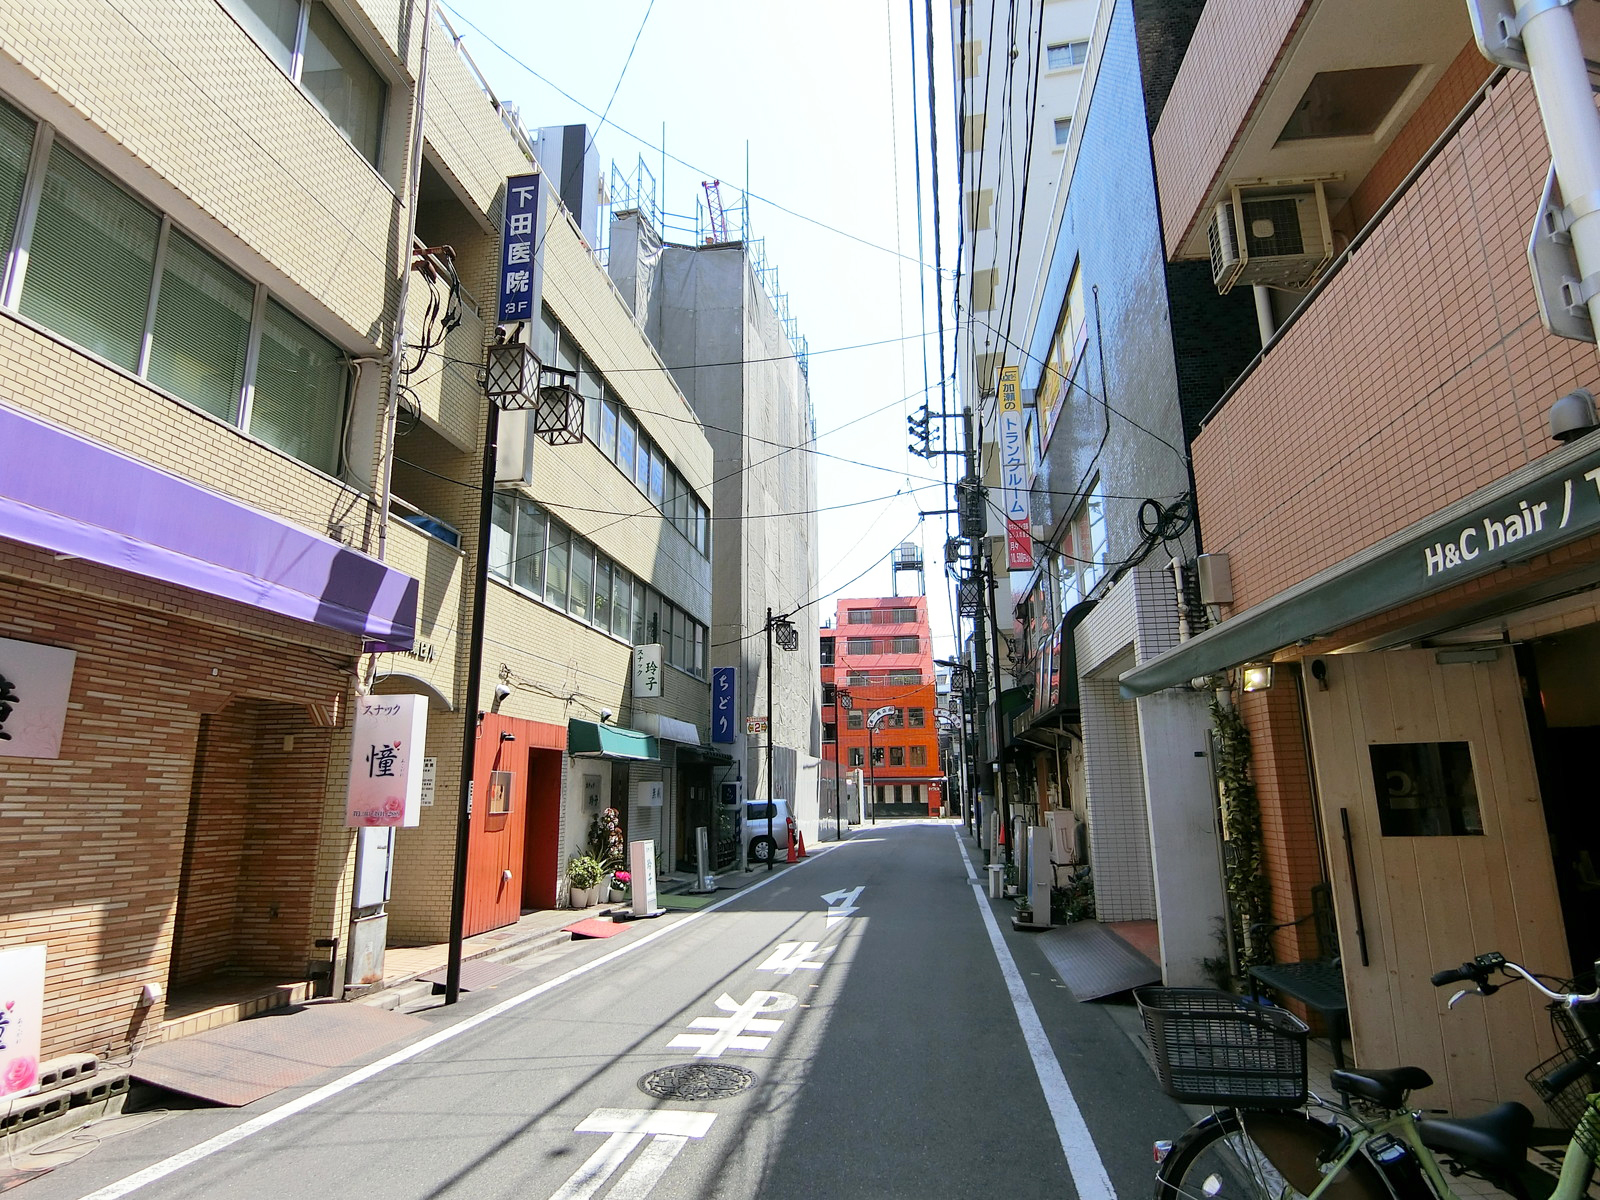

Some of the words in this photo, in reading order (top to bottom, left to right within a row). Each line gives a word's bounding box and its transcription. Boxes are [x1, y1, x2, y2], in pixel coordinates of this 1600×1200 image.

[505, 185, 535, 294] 下田医院
[505, 301, 528, 314] 3F
[1006, 417, 1024, 513] トランクルーム
[1424, 527, 1479, 577] H&C
[1482, 500, 1548, 551] hair
[645, 660, 659, 692] 玲子
[363, 703, 401, 717] スナック
[718, 674, 731, 734] ちどり
[754, 722, 761, 733] 2
[366, 744, 398, 778] 憧
